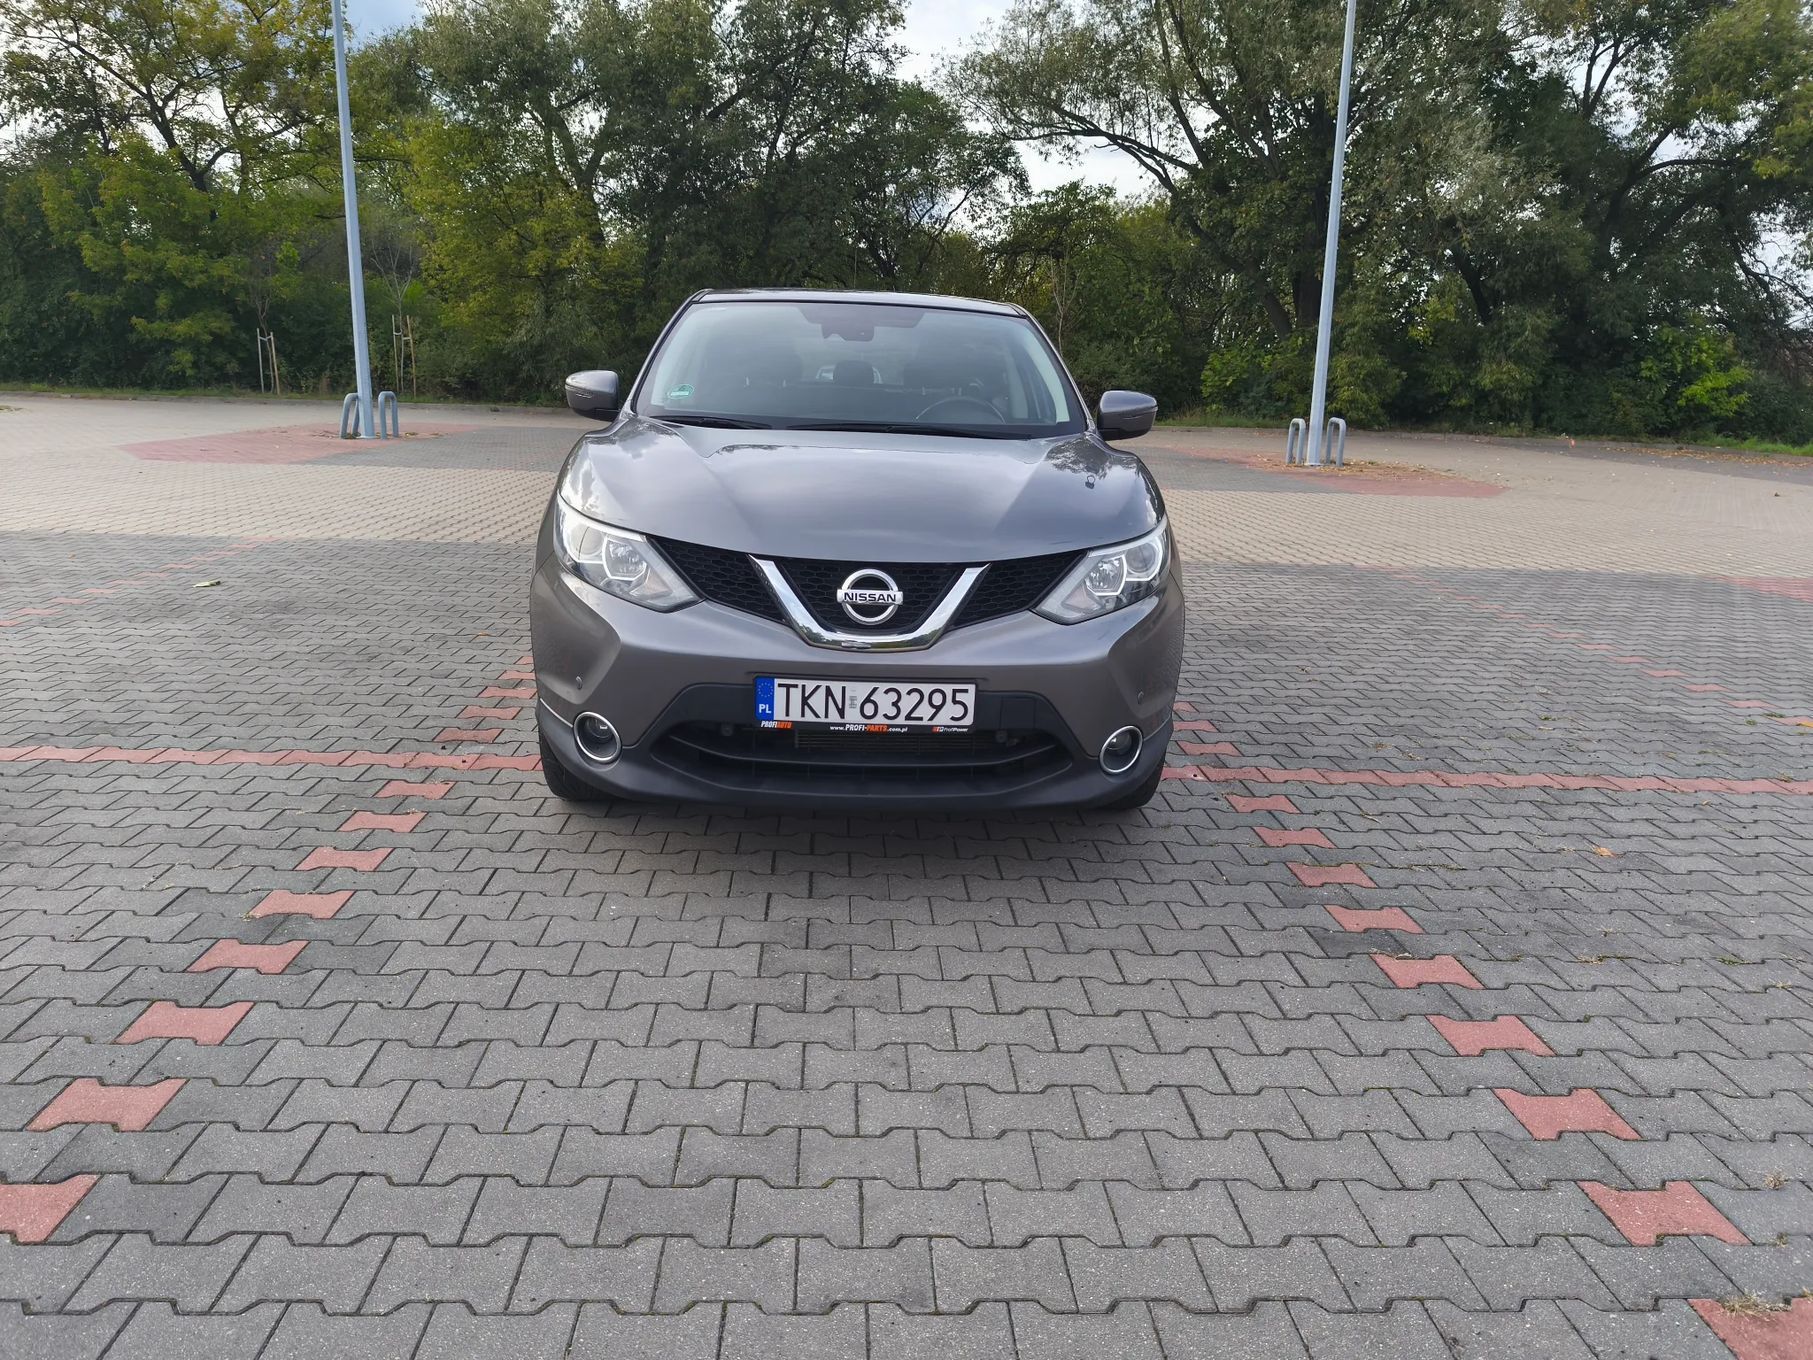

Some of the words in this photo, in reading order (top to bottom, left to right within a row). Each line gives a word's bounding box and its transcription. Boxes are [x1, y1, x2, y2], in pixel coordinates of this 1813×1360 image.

[844, 592, 897, 602] NISSAN
[778, 683, 847, 719] TKN
[859, 687, 970, 721] 63295
[758, 704, 772, 714] PL
[830, 724, 908, 734] www.PROFI-PARTS.com.pl
